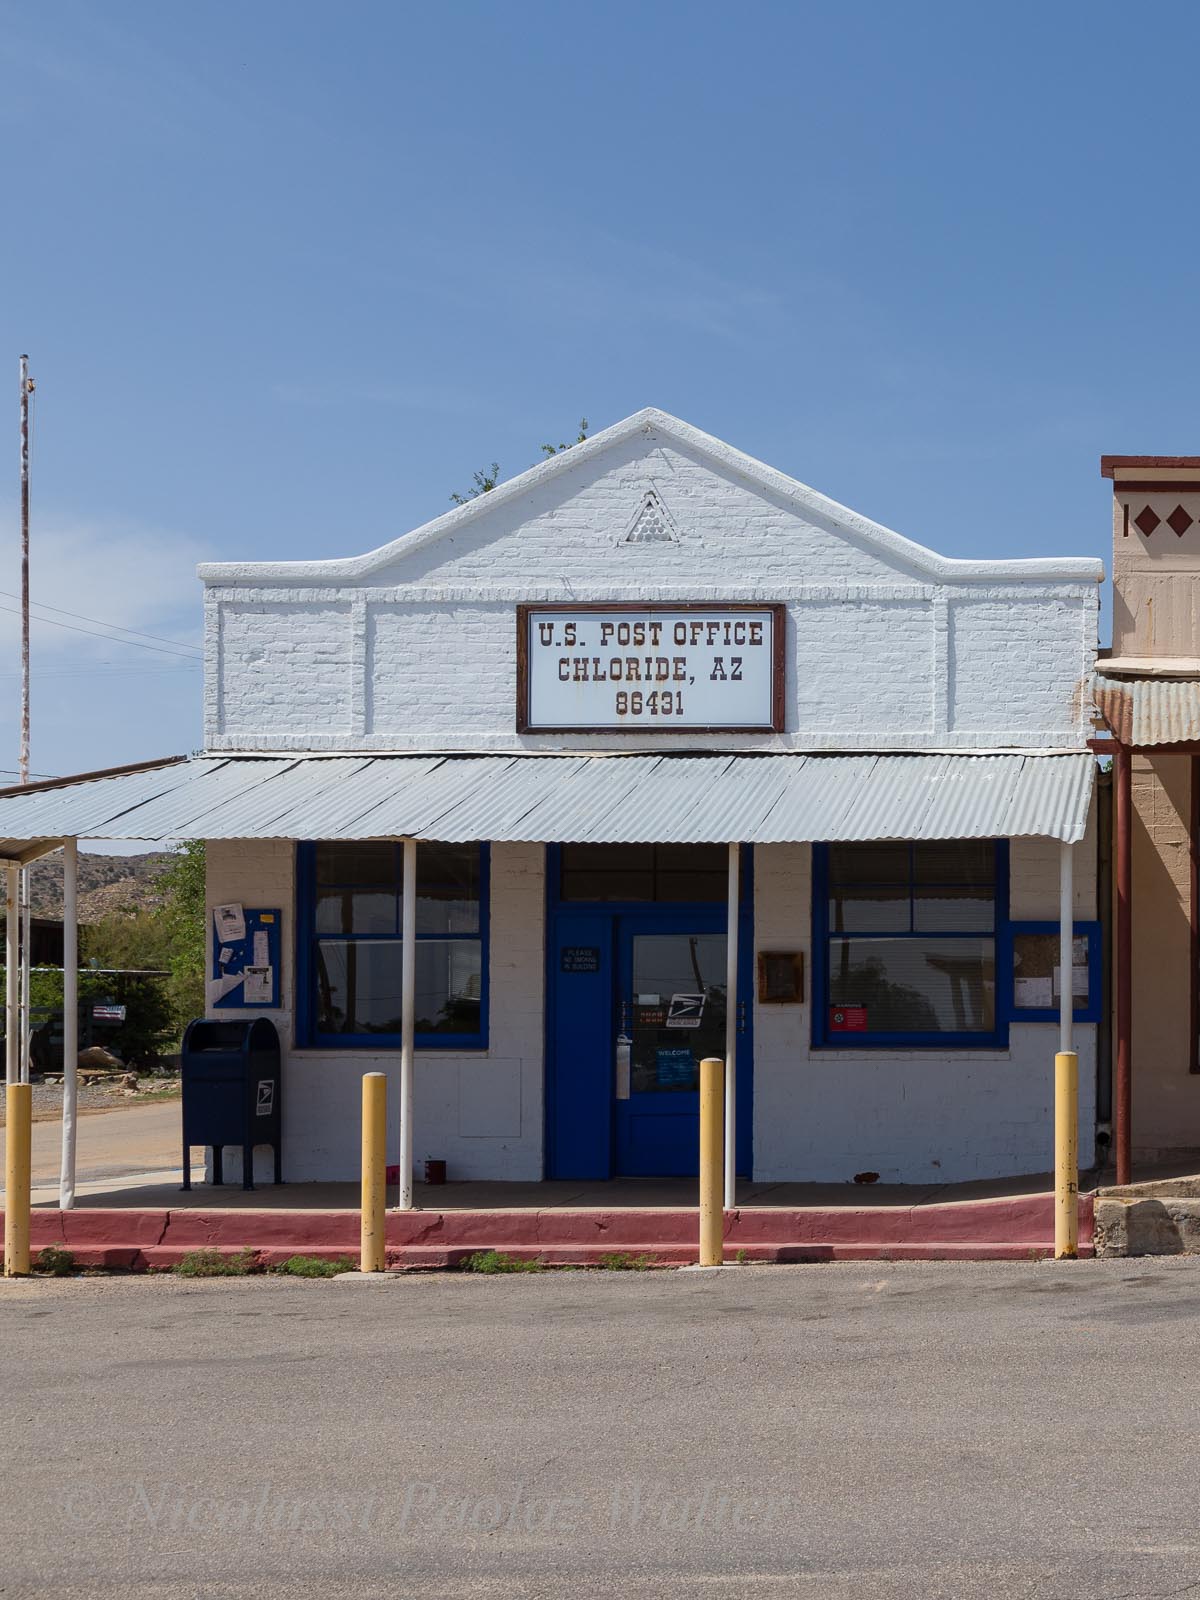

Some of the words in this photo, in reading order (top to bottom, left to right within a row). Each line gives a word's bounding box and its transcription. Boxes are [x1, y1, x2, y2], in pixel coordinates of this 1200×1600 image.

[538, 622, 586, 647] U.S.
[600, 622, 663, 647] POST
[673, 621, 763, 647] OFFICE
[558, 657, 695, 685] CHLORIDE,
[710, 657, 743, 681] AZ
[616, 691, 684, 715] 86431
